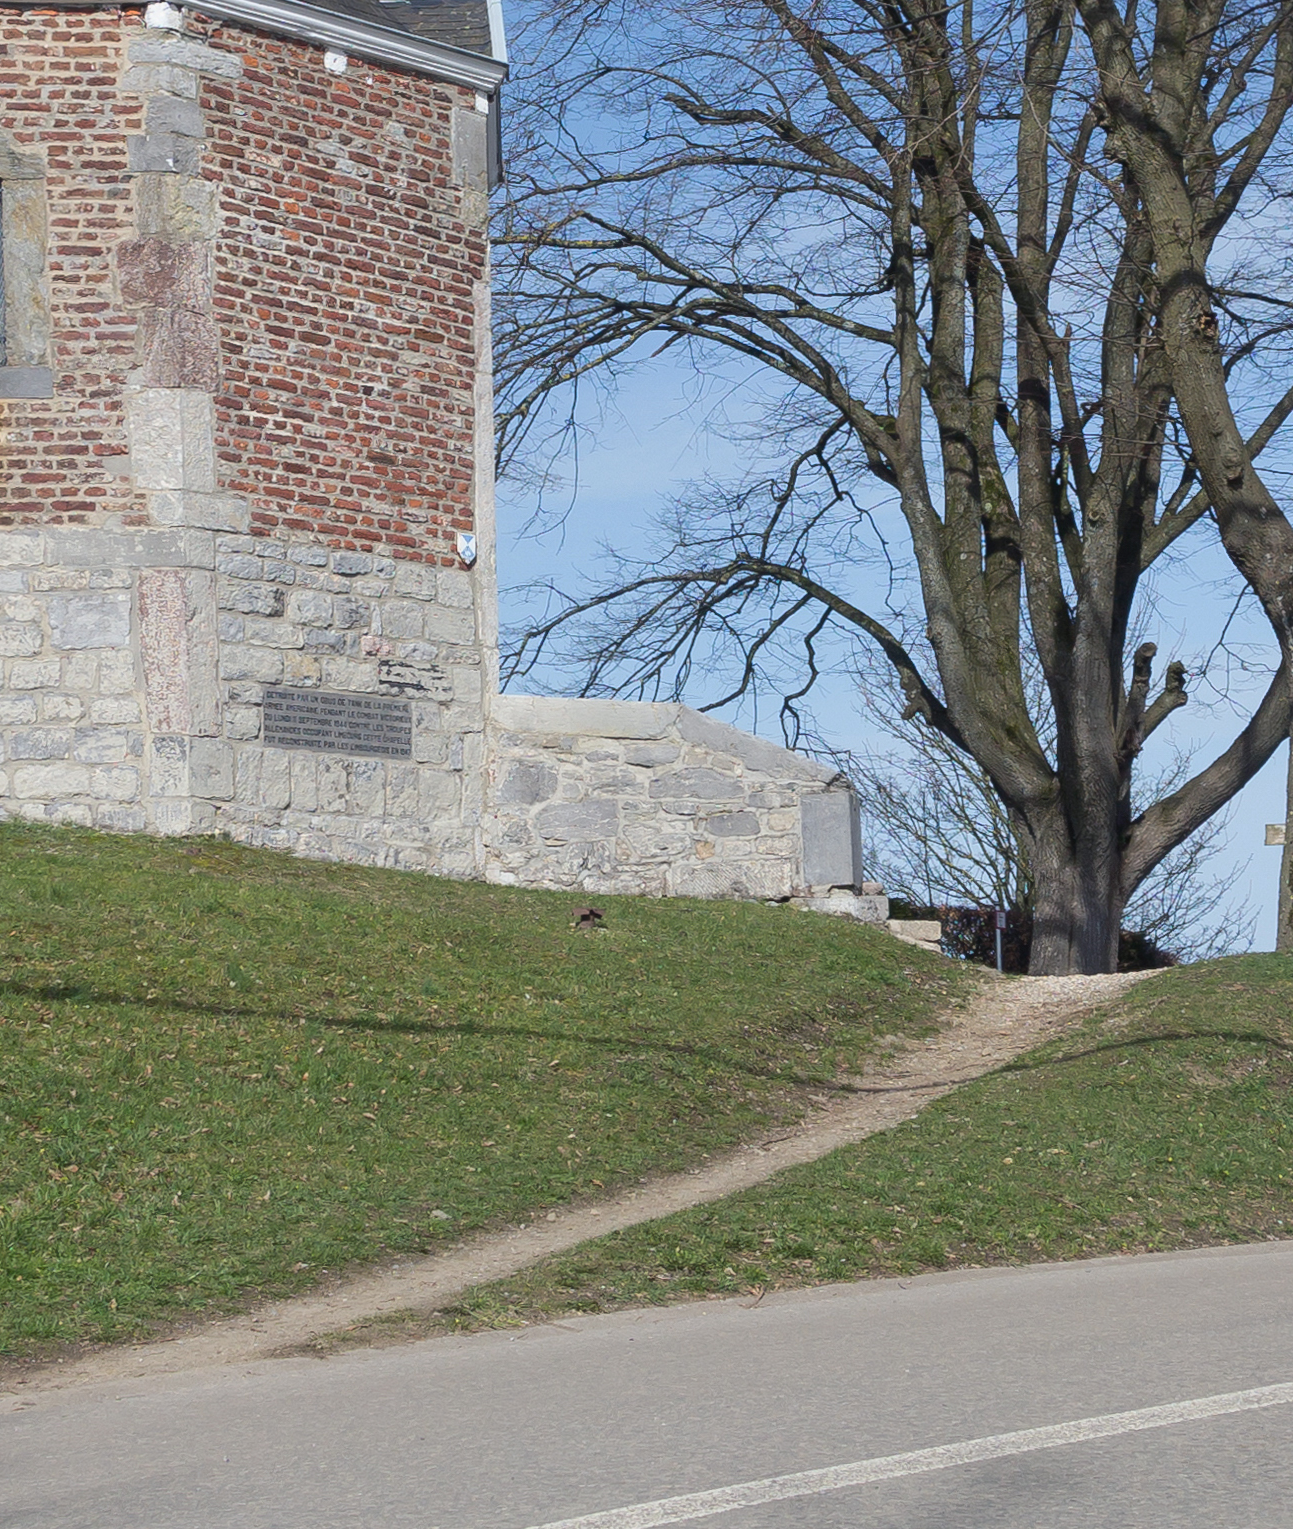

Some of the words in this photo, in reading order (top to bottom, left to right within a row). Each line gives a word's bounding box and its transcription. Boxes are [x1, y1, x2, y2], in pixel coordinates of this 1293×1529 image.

[348, 700, 362, 708] TANK
[320, 708, 345, 717] PENDANT
[357, 712, 378, 720] COMBAT
[298, 717, 332, 727] SEPTEMBRE
[349, 722, 371, 731] CONTRE
[386, 725, 411, 734] TROUPES
[264, 725, 301, 735] ALLEMANDES
[303, 728, 332, 737] OCCUPANT
[363, 734, 381, 742] CETTE
[278, 737, 321, 748] RECONSTRUITE
